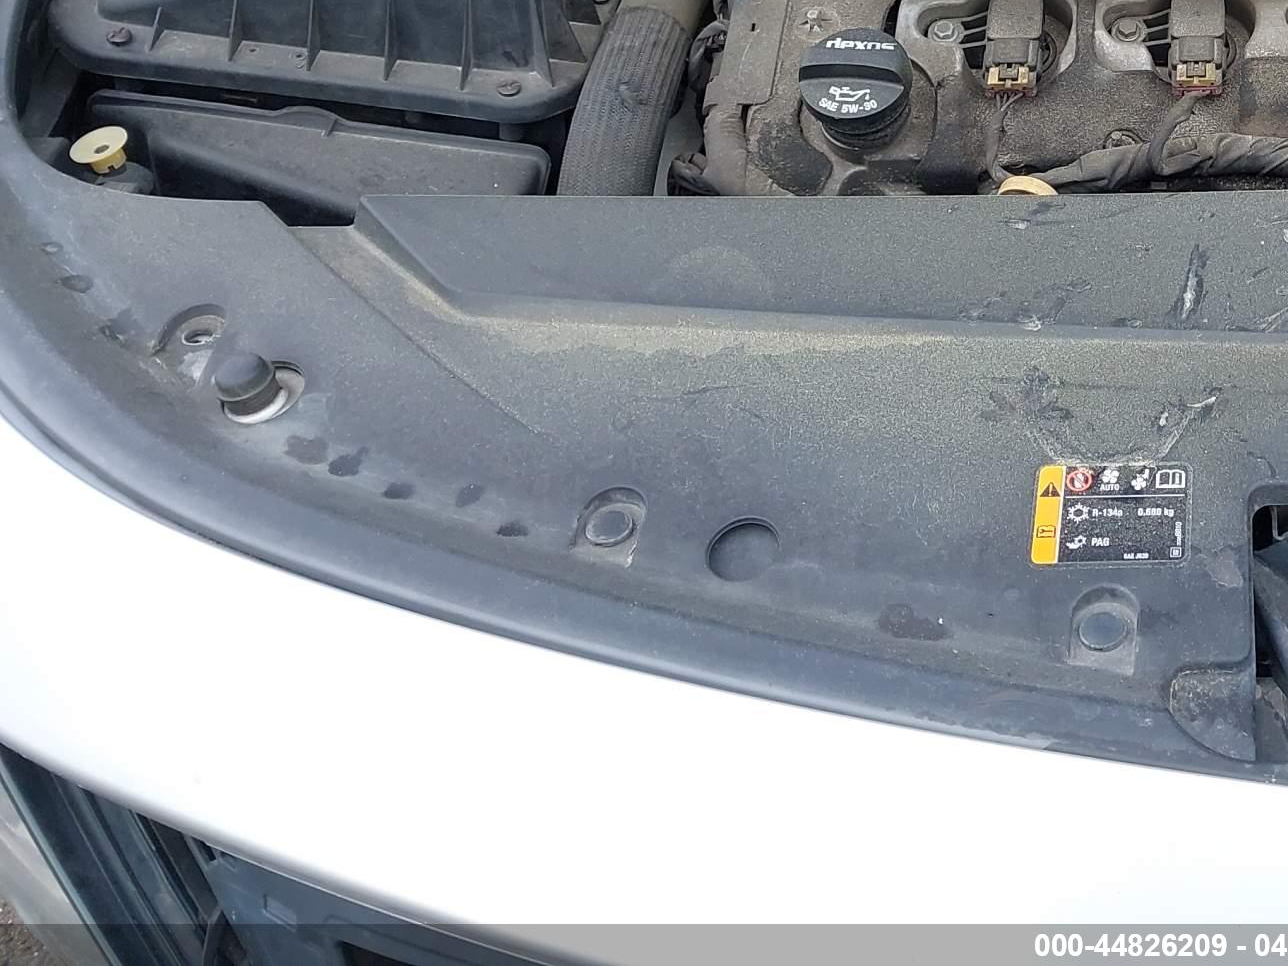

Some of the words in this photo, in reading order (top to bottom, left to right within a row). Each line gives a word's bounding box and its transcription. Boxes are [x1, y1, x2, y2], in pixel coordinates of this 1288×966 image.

[819, 97, 839, 112] SAE
[841, 99, 877, 113] 5W-30
[1092, 507, 1123, 516] R-134a
[1164, 507, 1174, 517] kg
[1091, 537, 1110, 546] PAG
